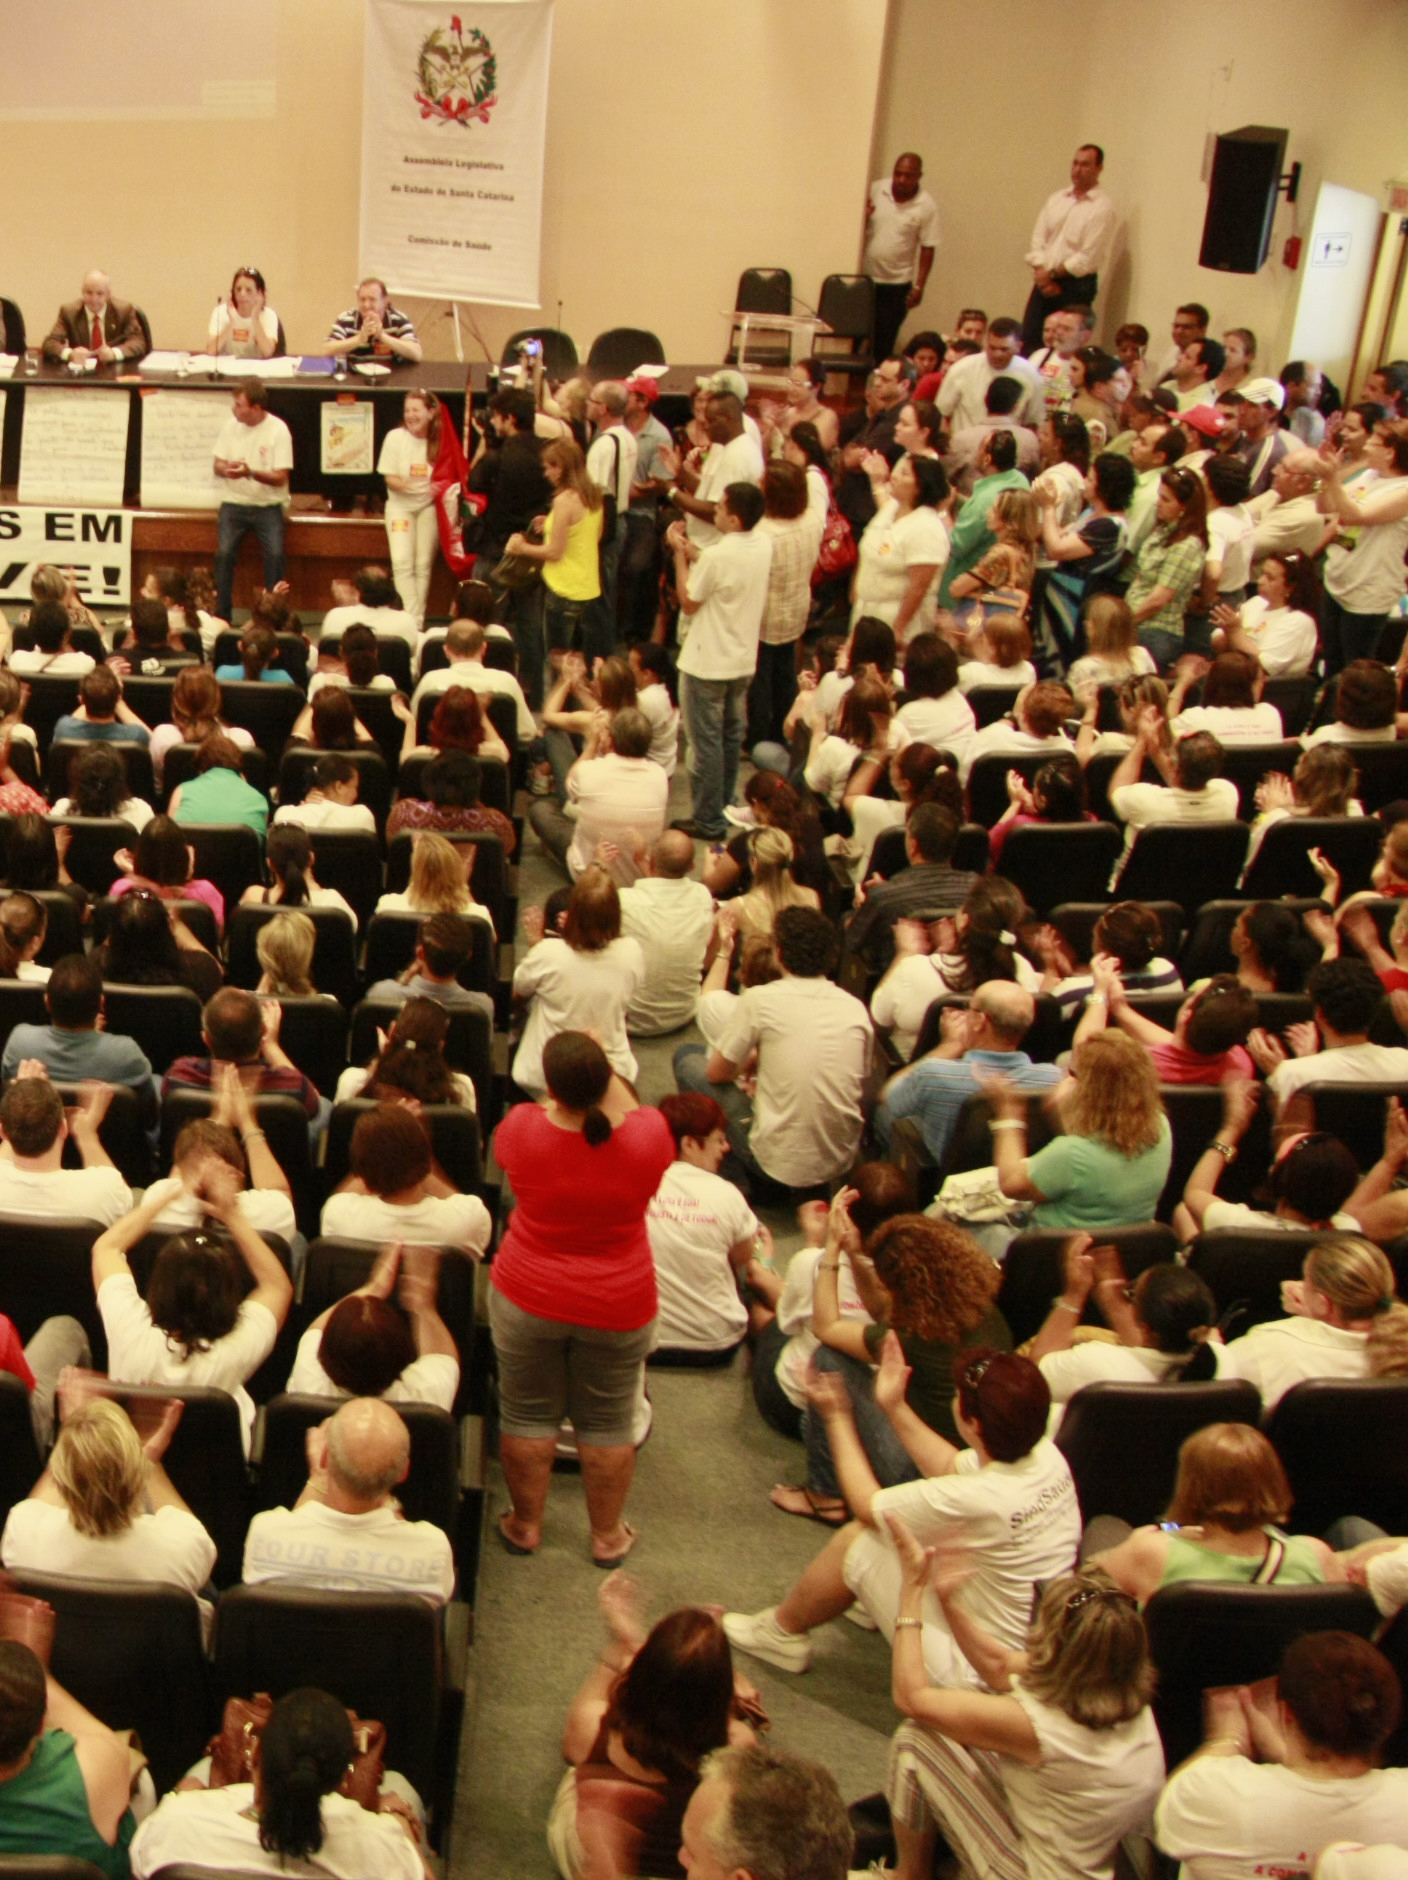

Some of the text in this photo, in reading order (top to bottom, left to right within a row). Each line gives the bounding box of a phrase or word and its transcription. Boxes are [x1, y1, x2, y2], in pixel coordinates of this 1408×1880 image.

[455, 159, 504, 171] Legislativa
[404, 184, 433, 194] Estado
[449, 188, 474, 198] Santa
[477, 190, 514, 202] Catarina
[44, 510, 124, 544] EM
